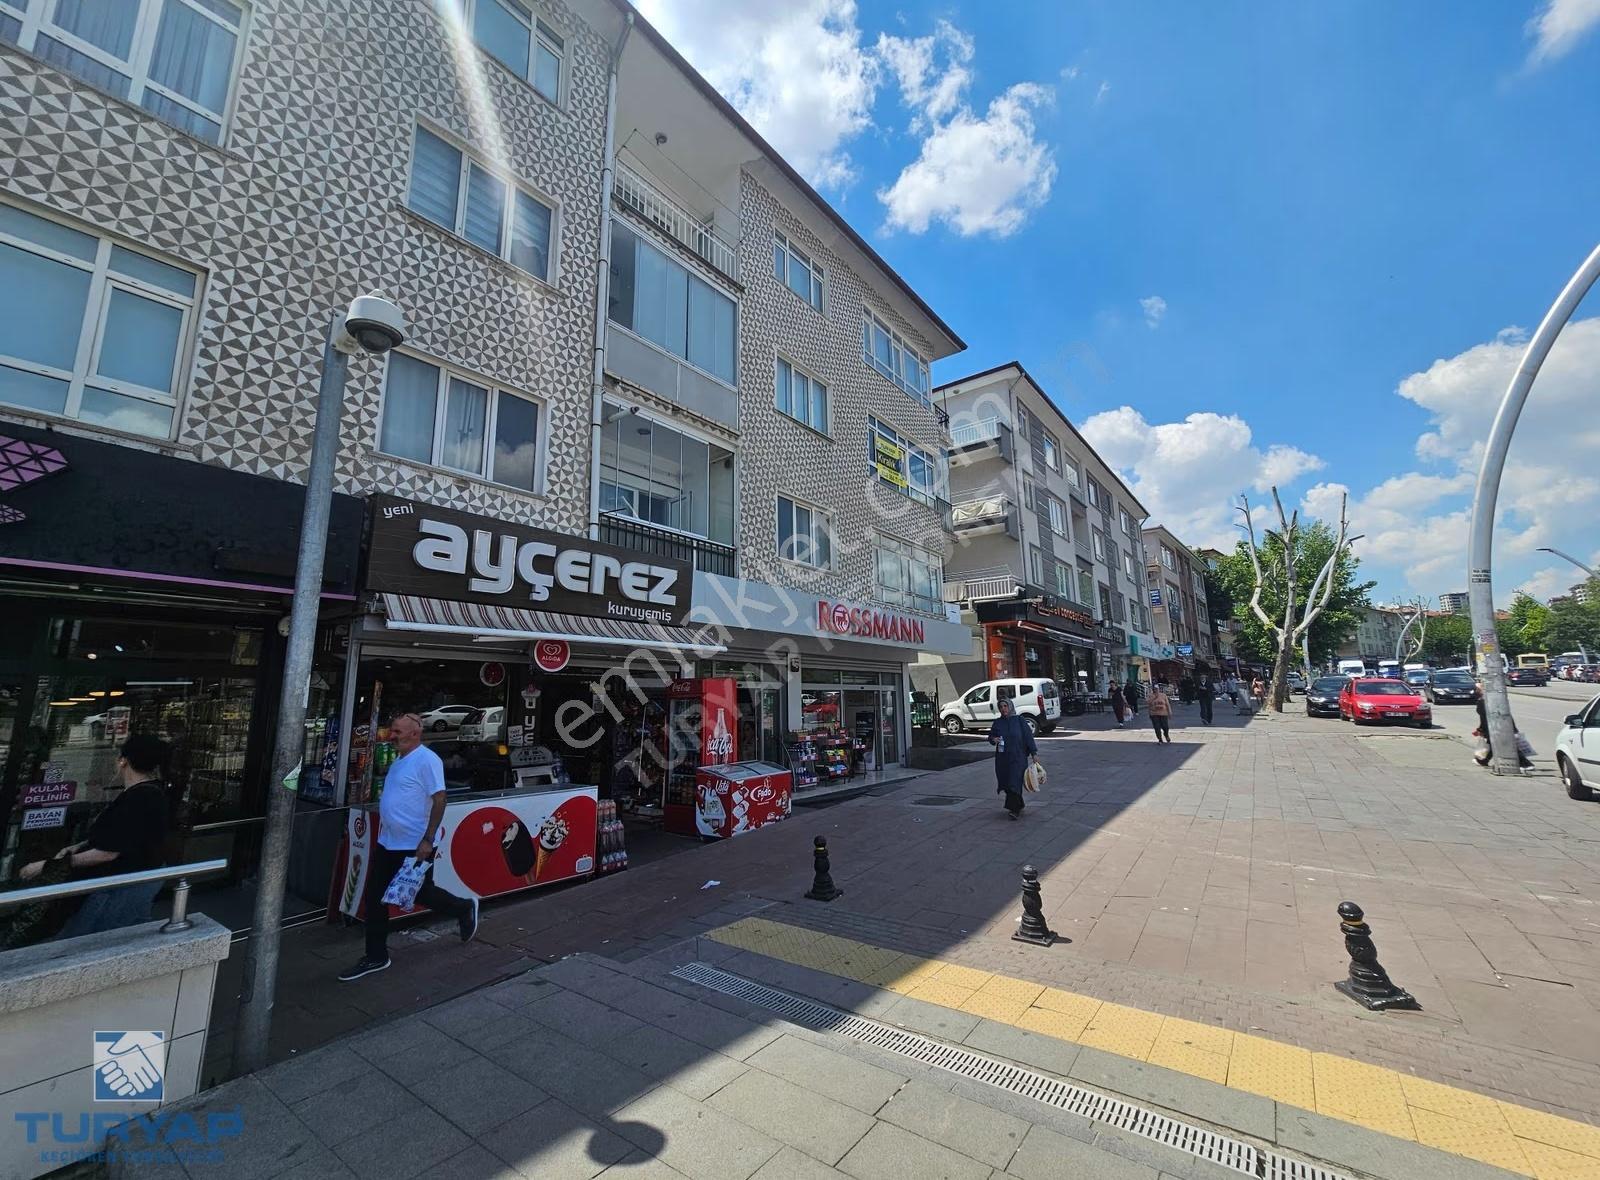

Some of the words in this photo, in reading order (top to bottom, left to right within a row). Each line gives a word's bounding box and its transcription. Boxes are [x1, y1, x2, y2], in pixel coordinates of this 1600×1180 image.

[382, 502, 415, 520] yeni
[607, 600, 673, 623] kuruyemiş
[816, 601, 925, 645] ROSSMANN
[29, 783, 69, 794] KULAK
[24, 791, 71, 804] DELİNİR
[28, 810, 62, 820] BAYAN
